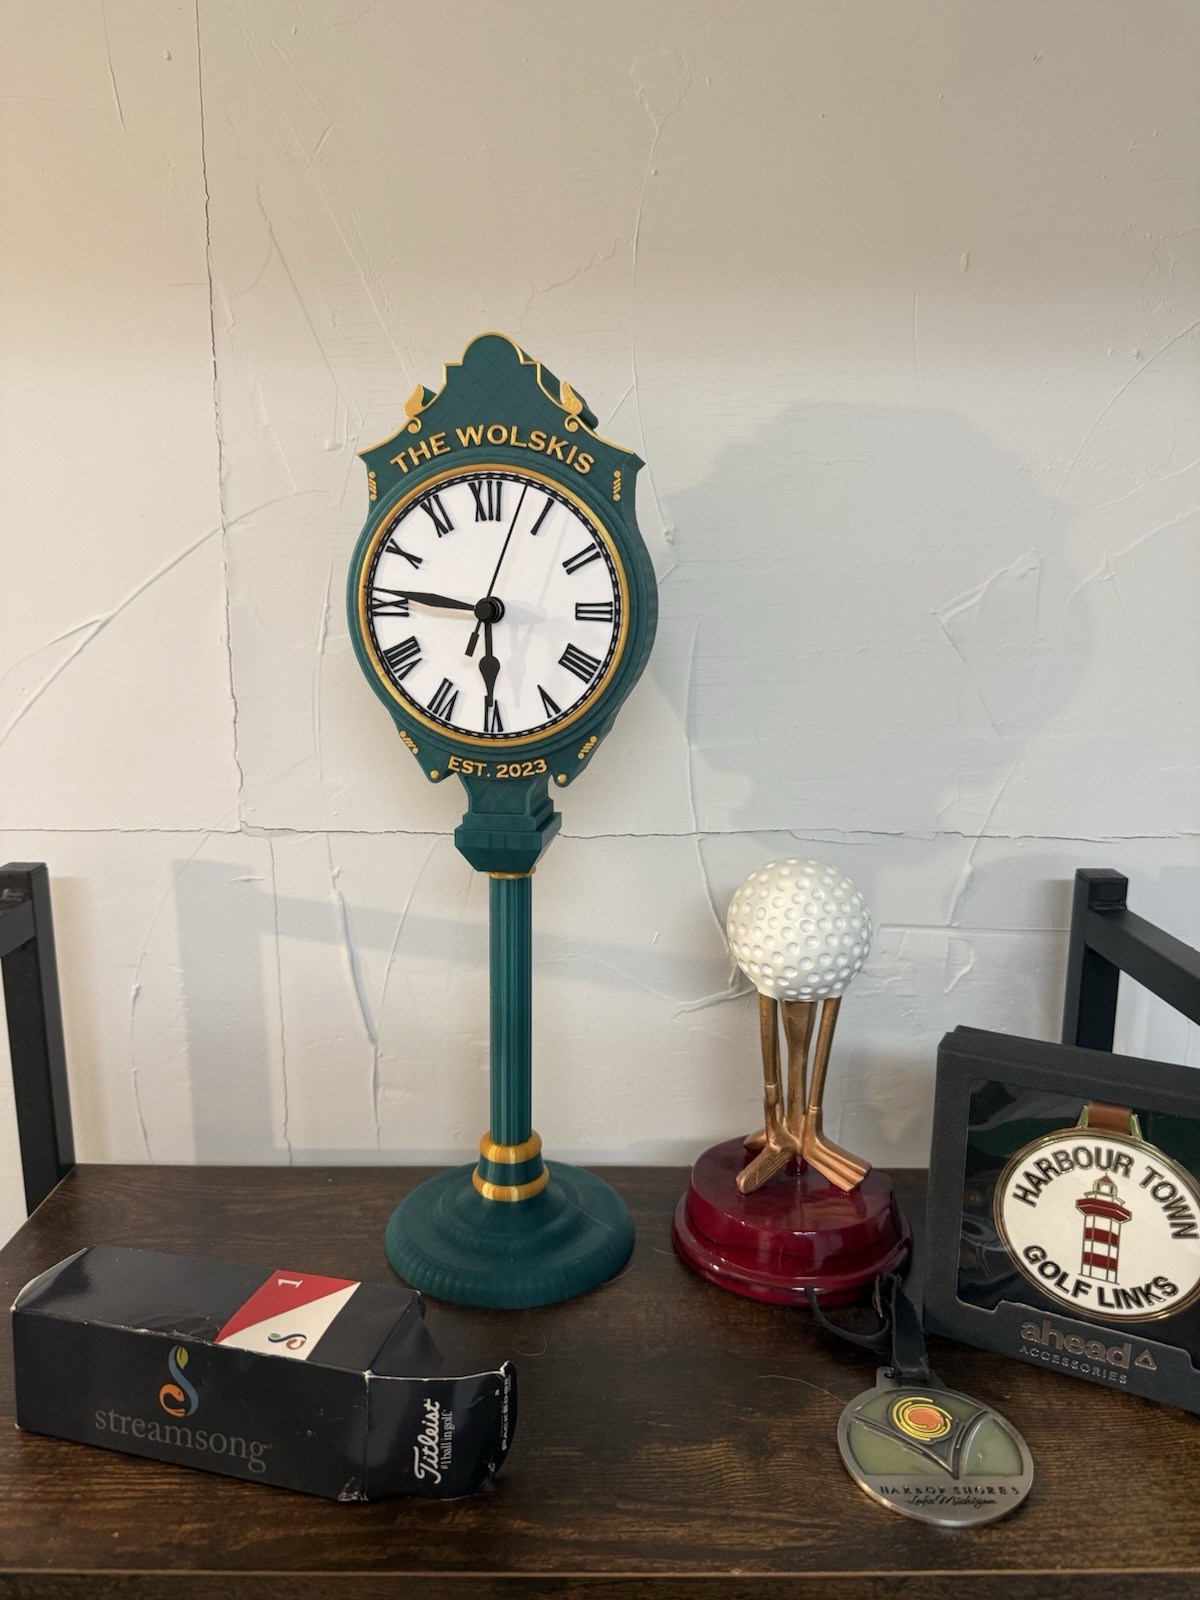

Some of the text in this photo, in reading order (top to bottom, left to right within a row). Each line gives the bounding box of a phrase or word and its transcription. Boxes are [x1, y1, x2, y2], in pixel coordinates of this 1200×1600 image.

[390, 424, 595, 475] THE WOLSKIS
[420, 494, 455, 538] XI
[468, 480, 503, 522] XII
[385, 538, 423, 570] X
[562, 542, 602, 575] II
[575, 601, 614, 623] III
[382, 635, 423, 681] VIII
[426, 677, 459, 721] VII
[537, 684, 562, 718] V
[447, 755, 548, 779] EST. 2023
[1012, 1146, 1199, 1239] HARBOUR TOWN
[278, 1278, 303, 1289] 1
[1022, 1245, 1179, 1309] GOLF LINKS
[1019, 1320, 1132, 1369] ahead
[1019, 1345, 1128, 1385] ACCESSORIES
[94, 1409, 269, 1473] streamsong
[413, 1398, 442, 1484] Titleist
[440, 1431, 452, 1441] in
[440, 1442, 452, 1460] ball
